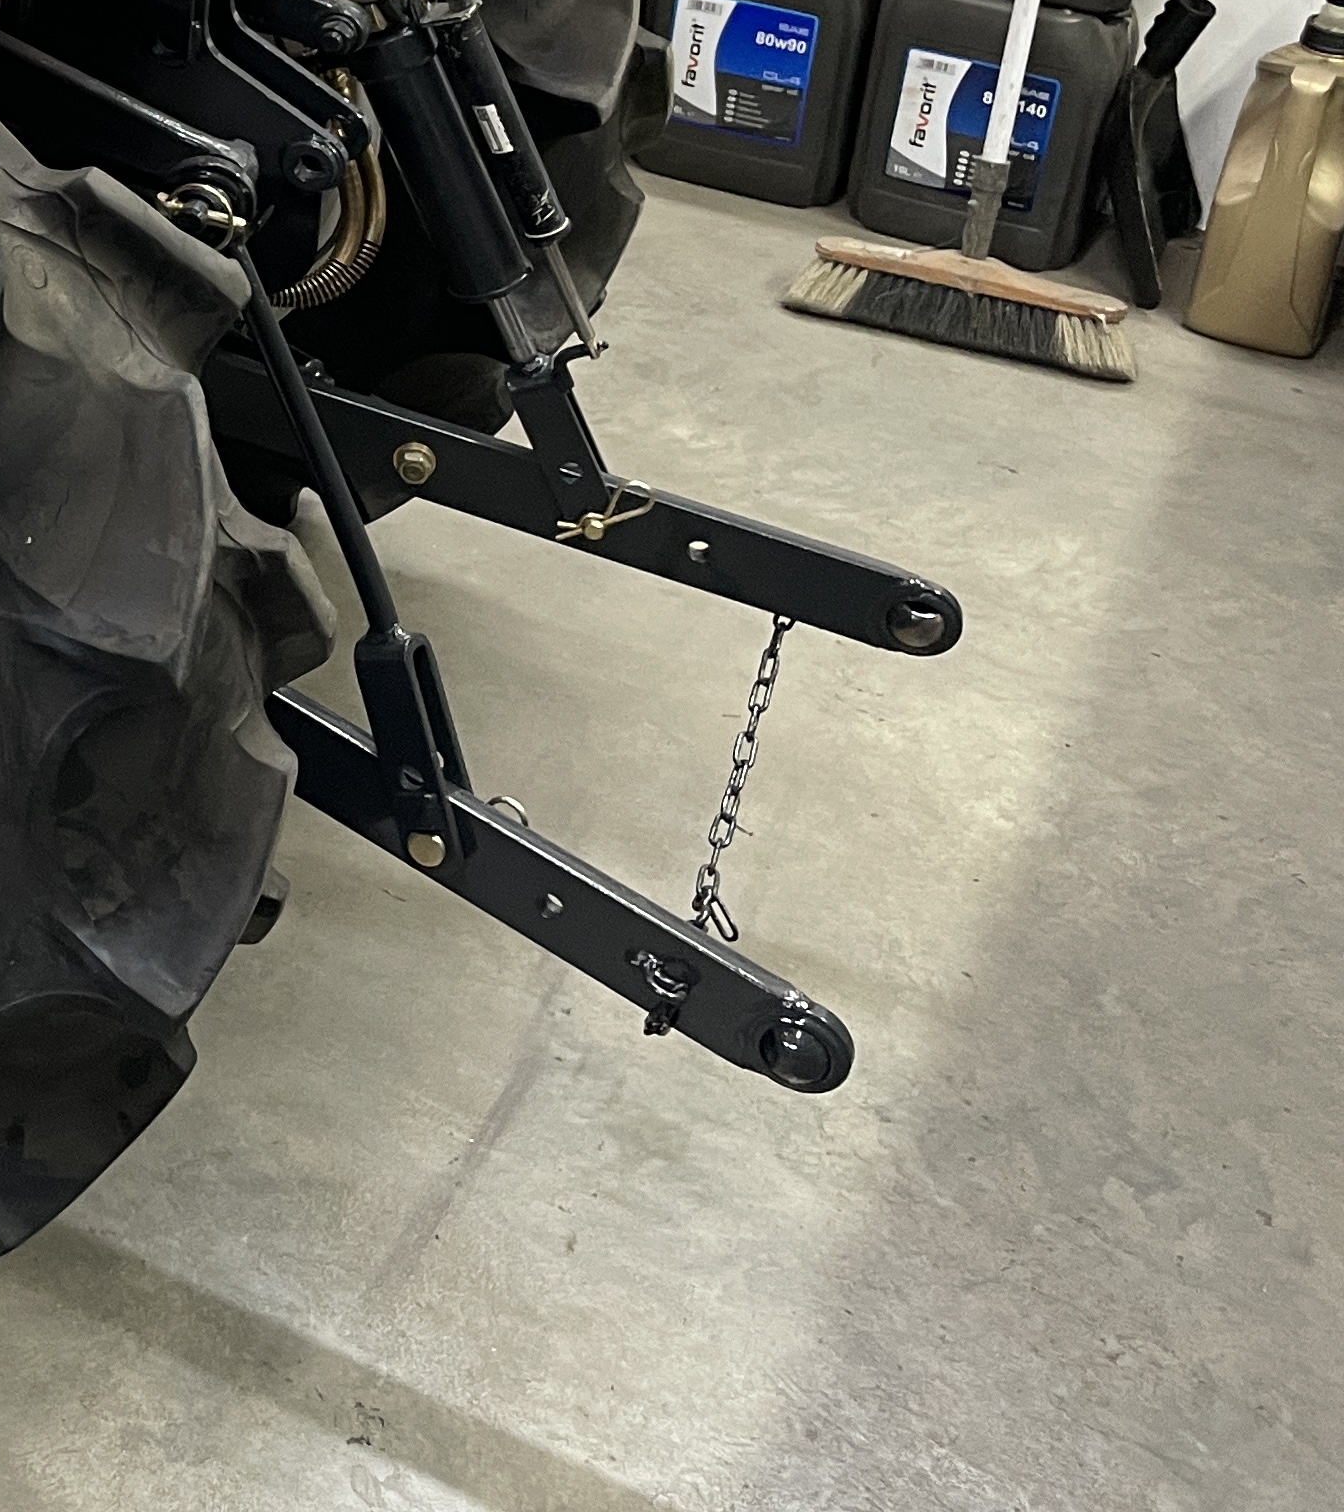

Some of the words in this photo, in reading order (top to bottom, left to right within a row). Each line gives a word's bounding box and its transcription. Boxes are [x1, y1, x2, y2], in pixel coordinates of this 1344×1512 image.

[681, 22, 705, 88] favorit
[755, 31, 807, 54] 80w90
[908, 80, 937, 148] favorit
